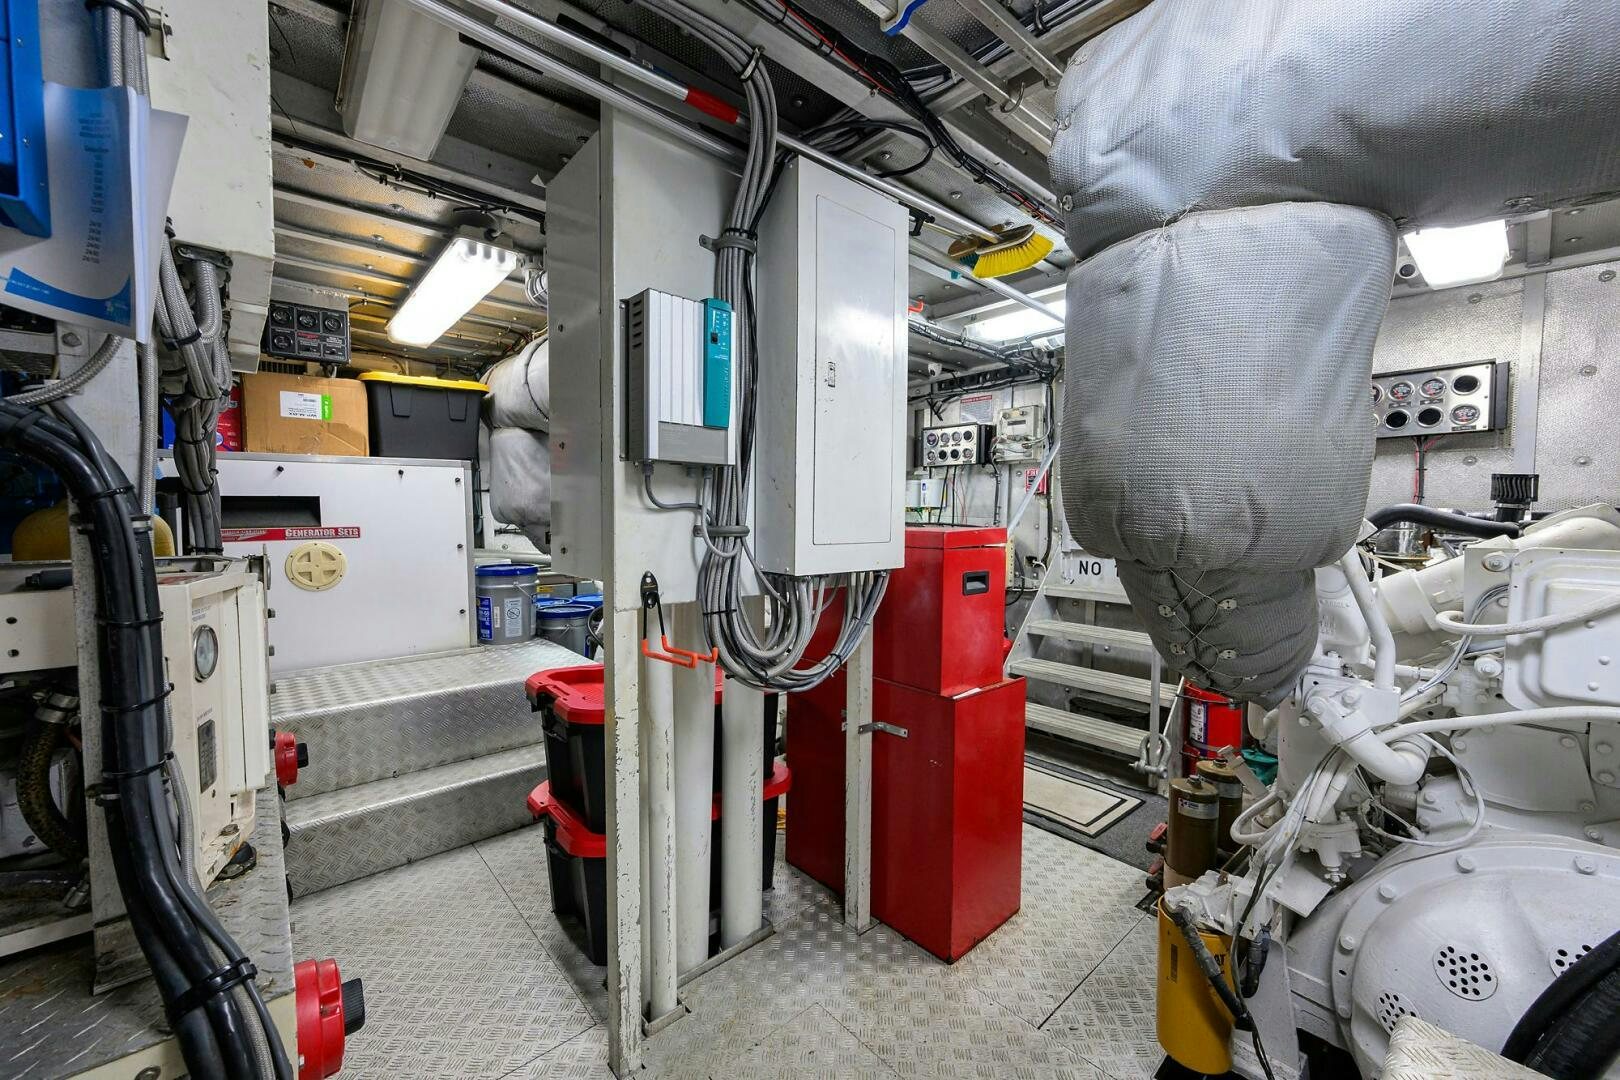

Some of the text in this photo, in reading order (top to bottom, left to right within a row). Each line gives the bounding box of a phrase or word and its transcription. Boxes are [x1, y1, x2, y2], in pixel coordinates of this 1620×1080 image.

[285, 527, 359, 537] GENERATOR SETS
[1079, 560, 1101, 576] NO
